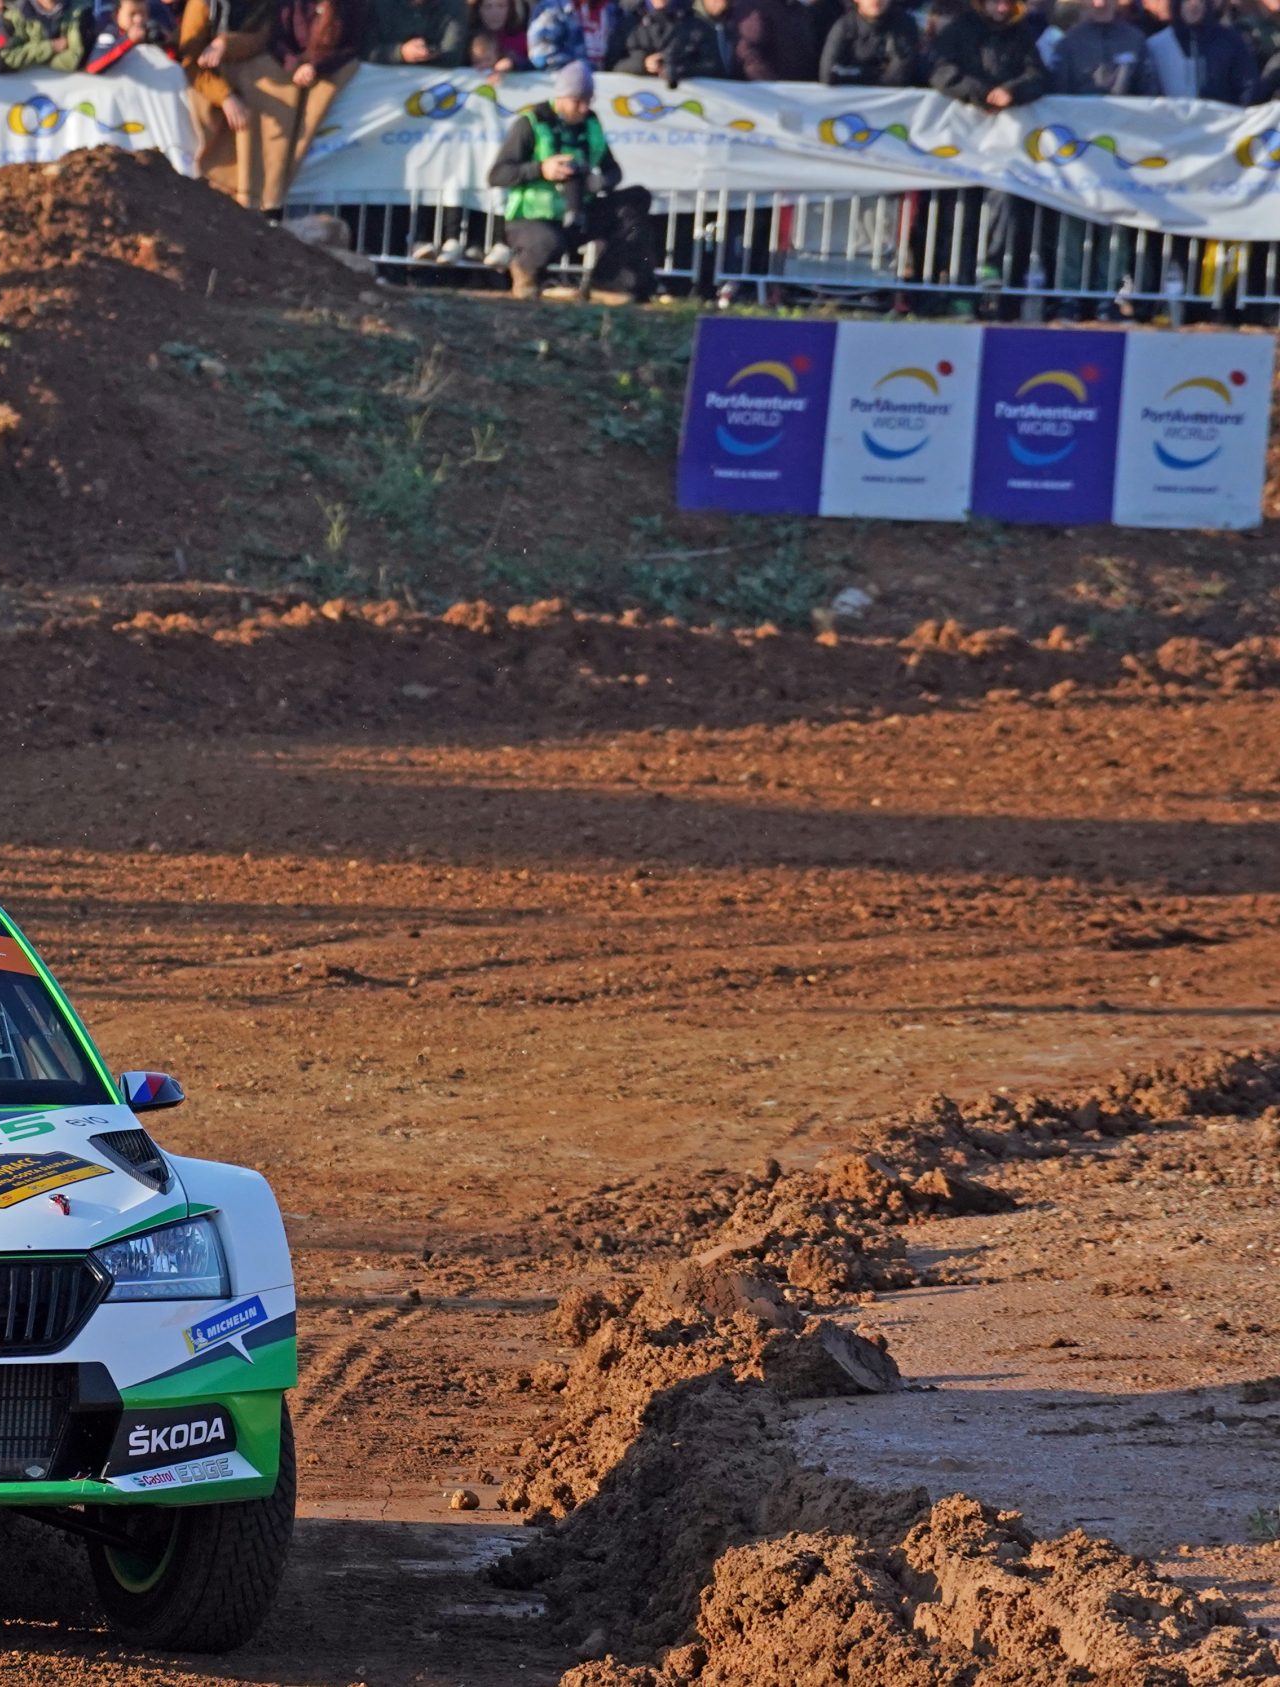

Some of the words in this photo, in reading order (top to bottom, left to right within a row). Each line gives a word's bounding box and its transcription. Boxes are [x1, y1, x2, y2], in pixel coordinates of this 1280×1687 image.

[65, 1115, 110, 1127] evo
[206, 1306, 258, 1339] MICHELIN
[128, 1417, 226, 1457] ŠKODA
[142, 1470, 176, 1487] Castrol
[175, 1457, 234, 1483] EDGE
